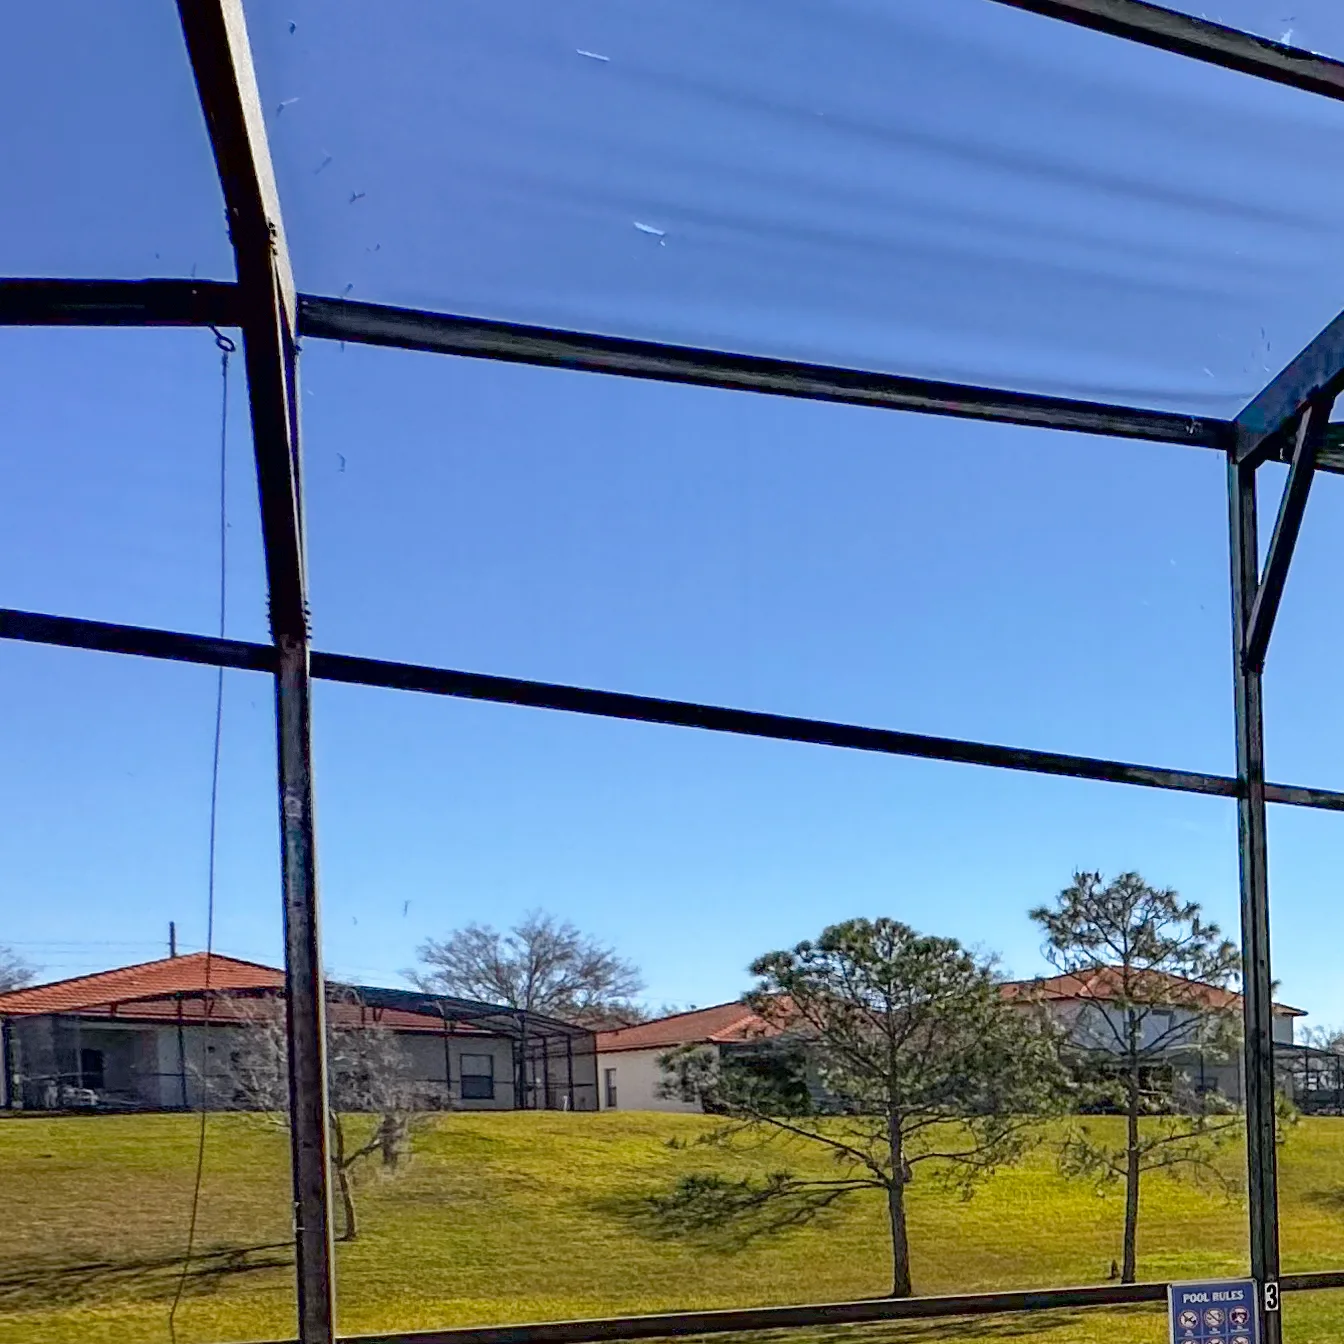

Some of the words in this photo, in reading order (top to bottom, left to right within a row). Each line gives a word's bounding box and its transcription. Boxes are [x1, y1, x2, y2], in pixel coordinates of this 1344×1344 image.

[1183, 1292, 1209, 1303] POOL
[1212, 1290, 1244, 1302] RULES
[1266, 1284, 1277, 1309] 3
